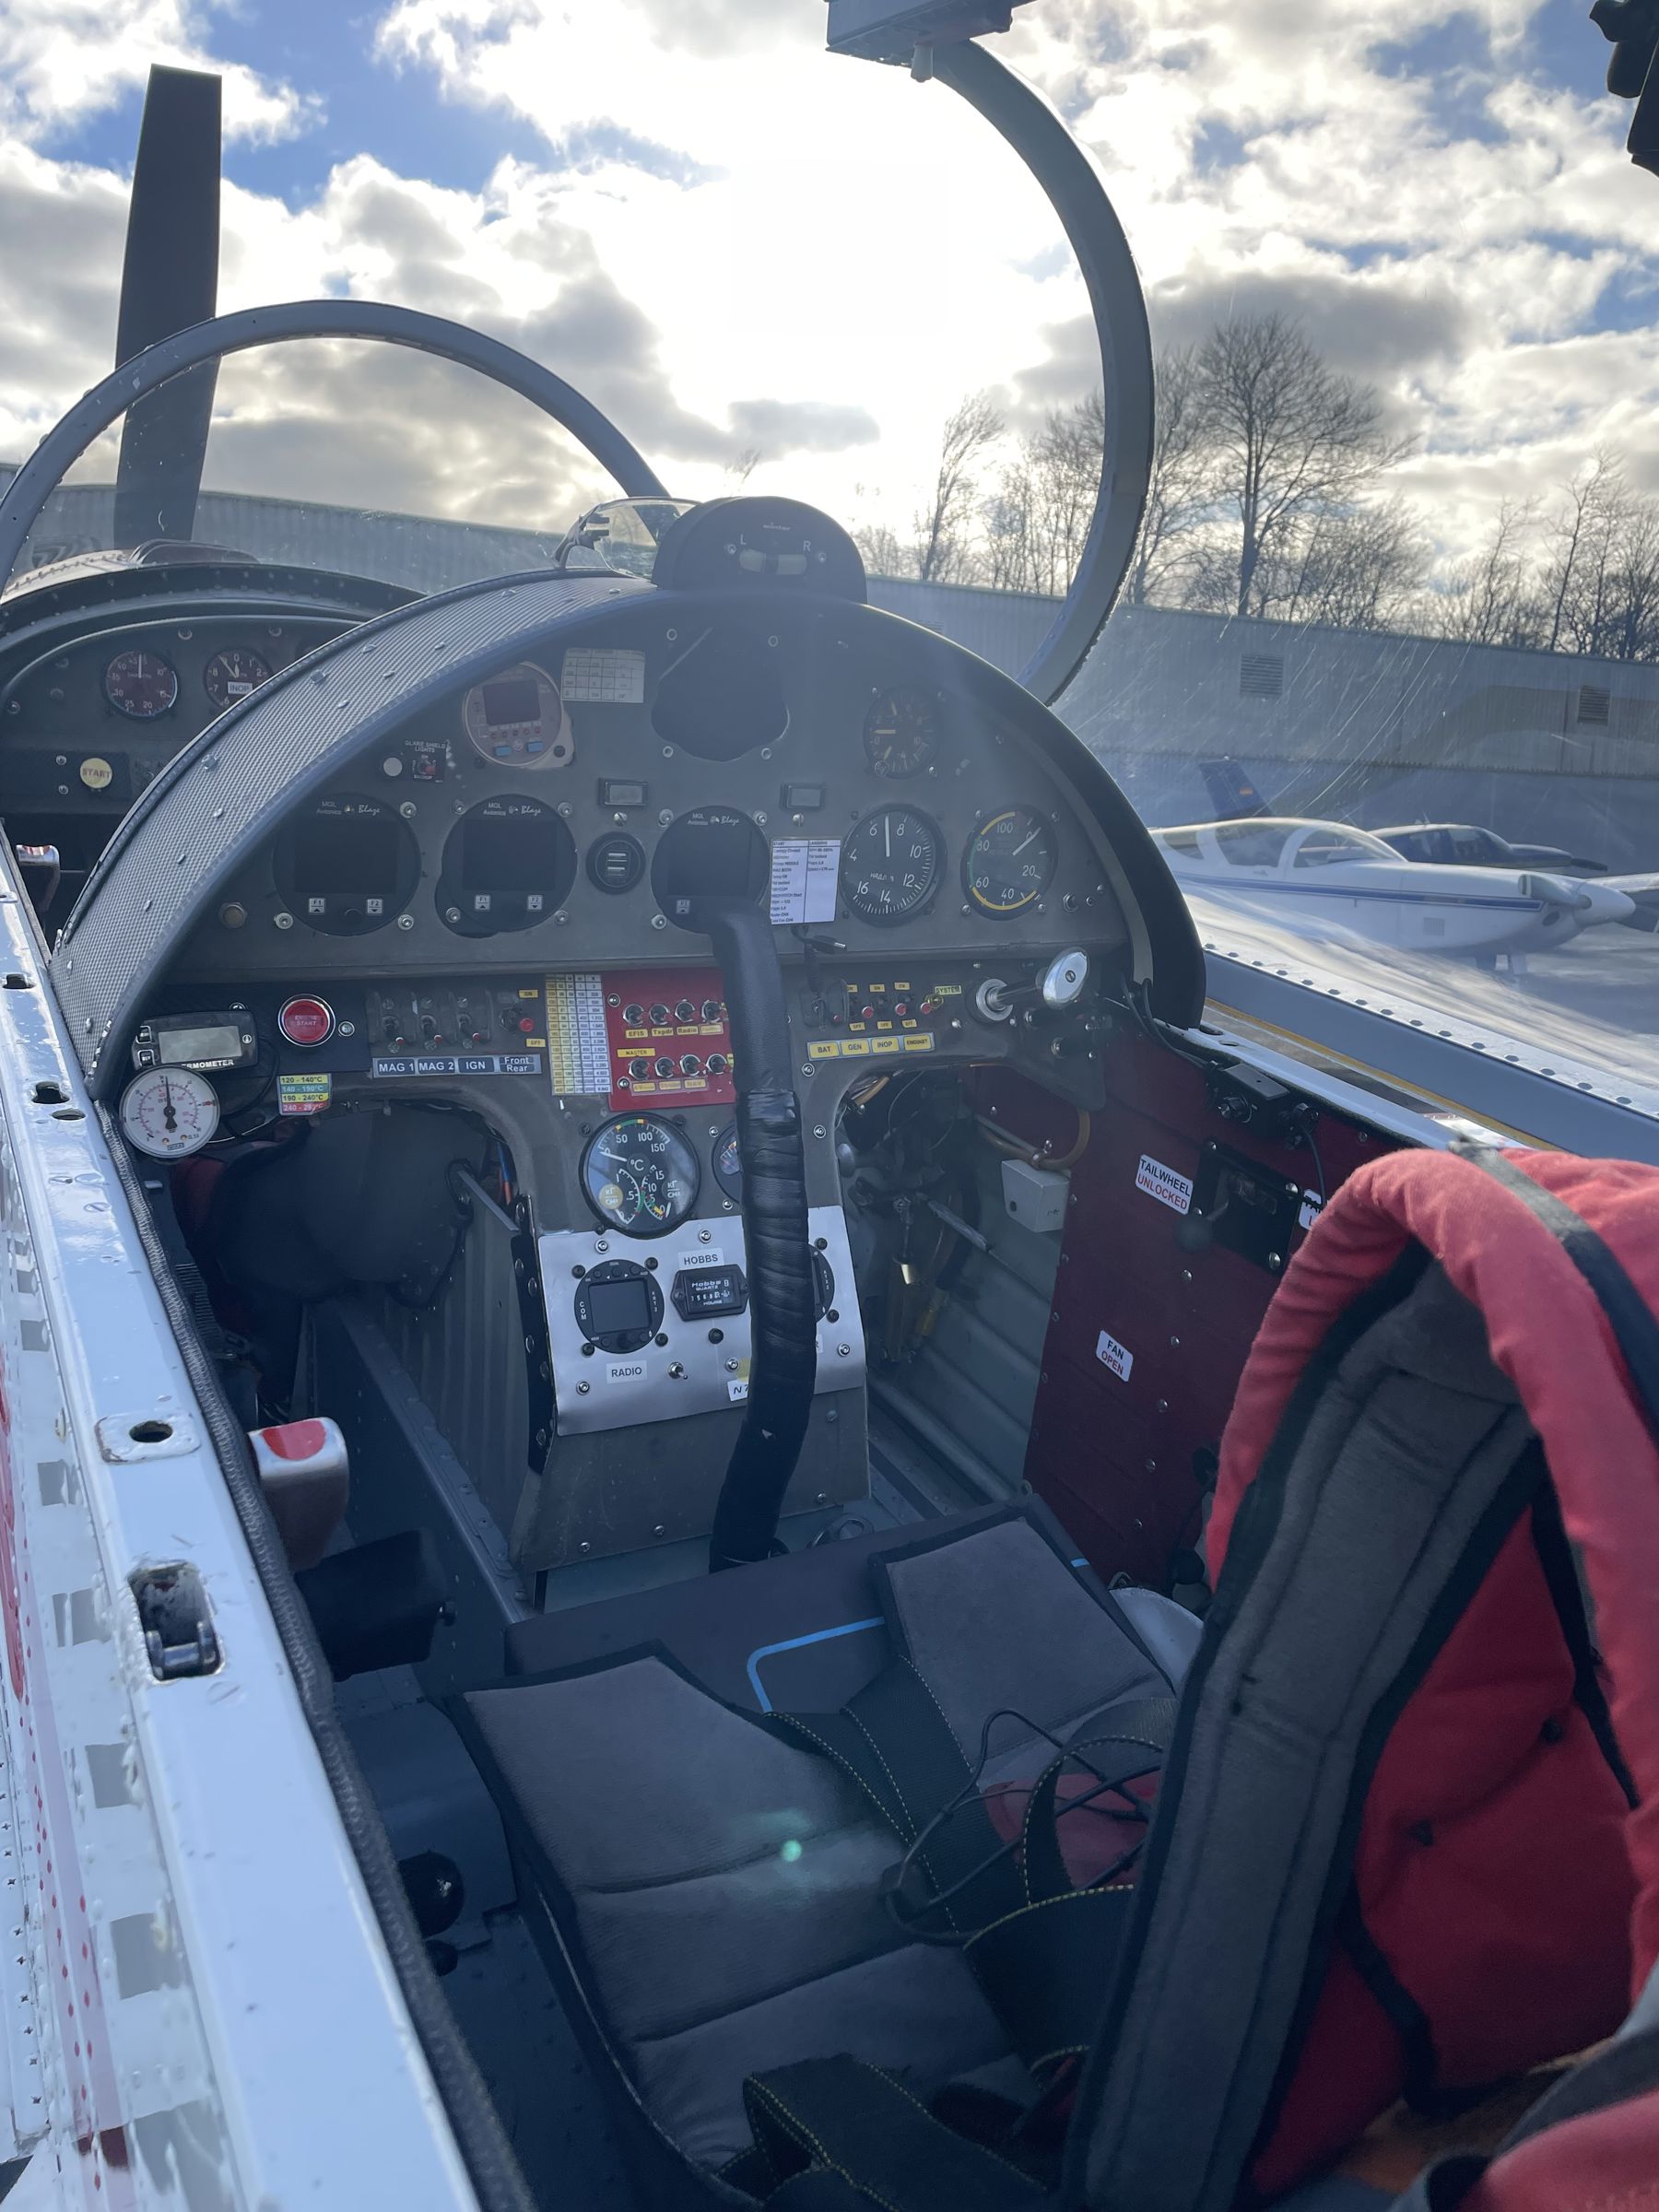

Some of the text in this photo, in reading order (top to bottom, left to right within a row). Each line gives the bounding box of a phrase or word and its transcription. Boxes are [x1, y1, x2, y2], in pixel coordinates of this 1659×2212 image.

[740, 535, 747, 545] L
[804, 540, 811, 552] R
[82, 768, 112, 780] START
[869, 823, 877, 837] 6
[896, 823, 905, 837] 8
[997, 822, 1014, 833] 100
[976, 840, 990, 852] 80
[910, 845, 923, 859] 10
[1021, 865, 1036, 877] 20
[902, 873, 915, 888] 12
[976, 877, 989, 888] 60
[856, 880, 869, 895] 16
[880, 889, 891, 904] 14
[1001, 888, 1015, 900] 40
[877, 1041, 893, 1049] INOP
[465, 1061, 487, 1070] IGN
[504, 1056, 529, 1065] Front
[379, 1064, 406, 1072] MAG
[418, 1062, 454, 1071] MAG 2
[616, 1134, 628, 1143] 50
[638, 1132, 653, 1142] 100
[651, 1143, 665, 1153] 150
[655, 1171, 665, 1181] 15
[1140, 1158, 1191, 1197] TAILWHEEL
[648, 1182, 657, 1193] 10
[1137, 1173, 1187, 1210] UNLOCKED
[683, 1254, 719, 1265] HOBBS
[691, 1280, 722, 1288] Hobbs
[579, 1300, 587, 1320] COM
[1107, 1339, 1124, 1360] FAN
[1101, 1350, 1124, 1375] OPEN
[611, 1367, 642, 1378] RADIO
